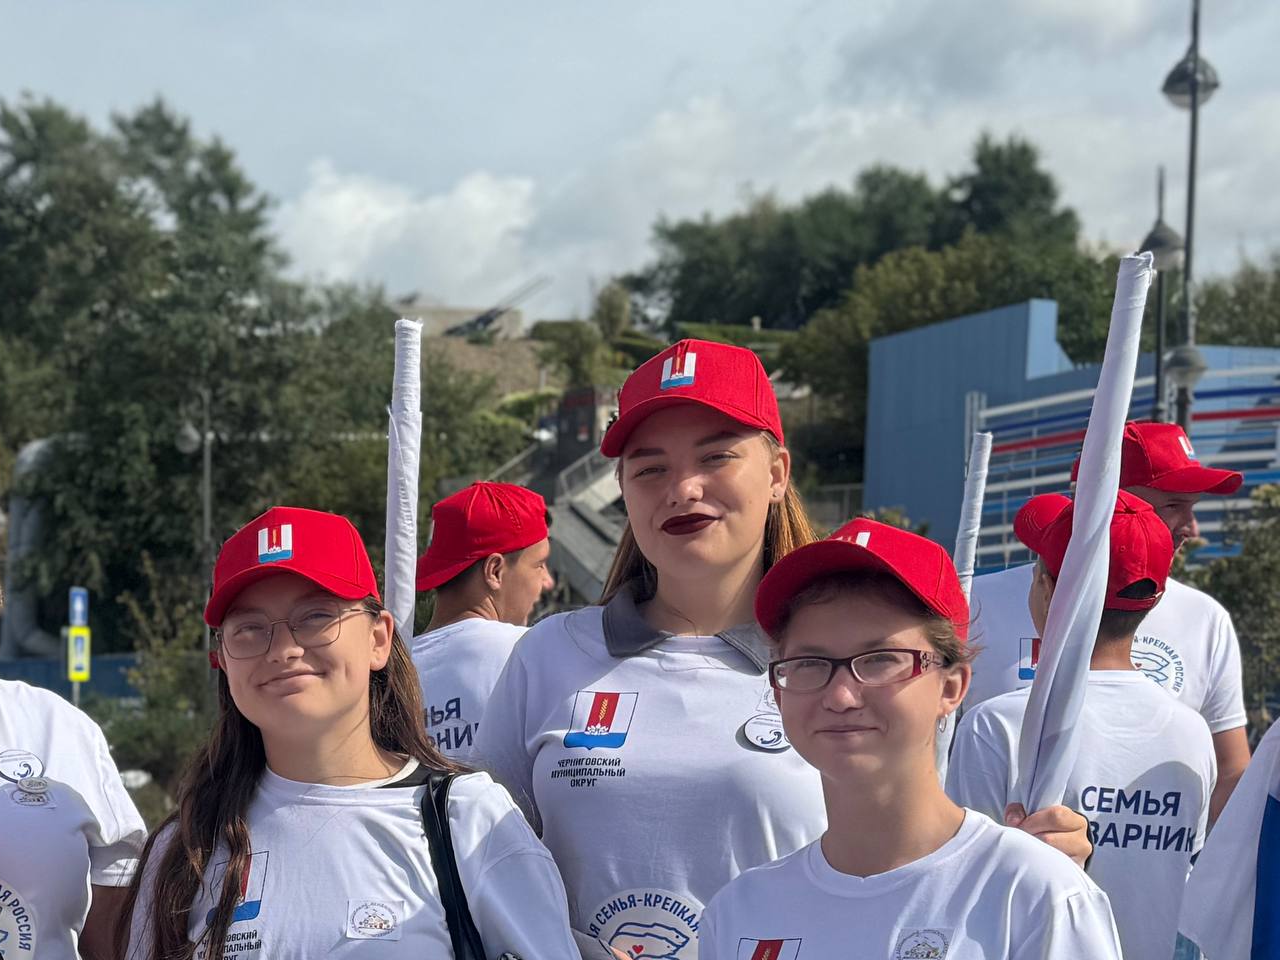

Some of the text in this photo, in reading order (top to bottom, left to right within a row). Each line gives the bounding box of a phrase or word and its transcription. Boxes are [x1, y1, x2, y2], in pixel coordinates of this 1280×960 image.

[570, 778, 598, 788] ОКРУГ
[1081, 785, 1182, 817] СЕМЬЯ
[7, 898, 32, 951] РОССИЯ
